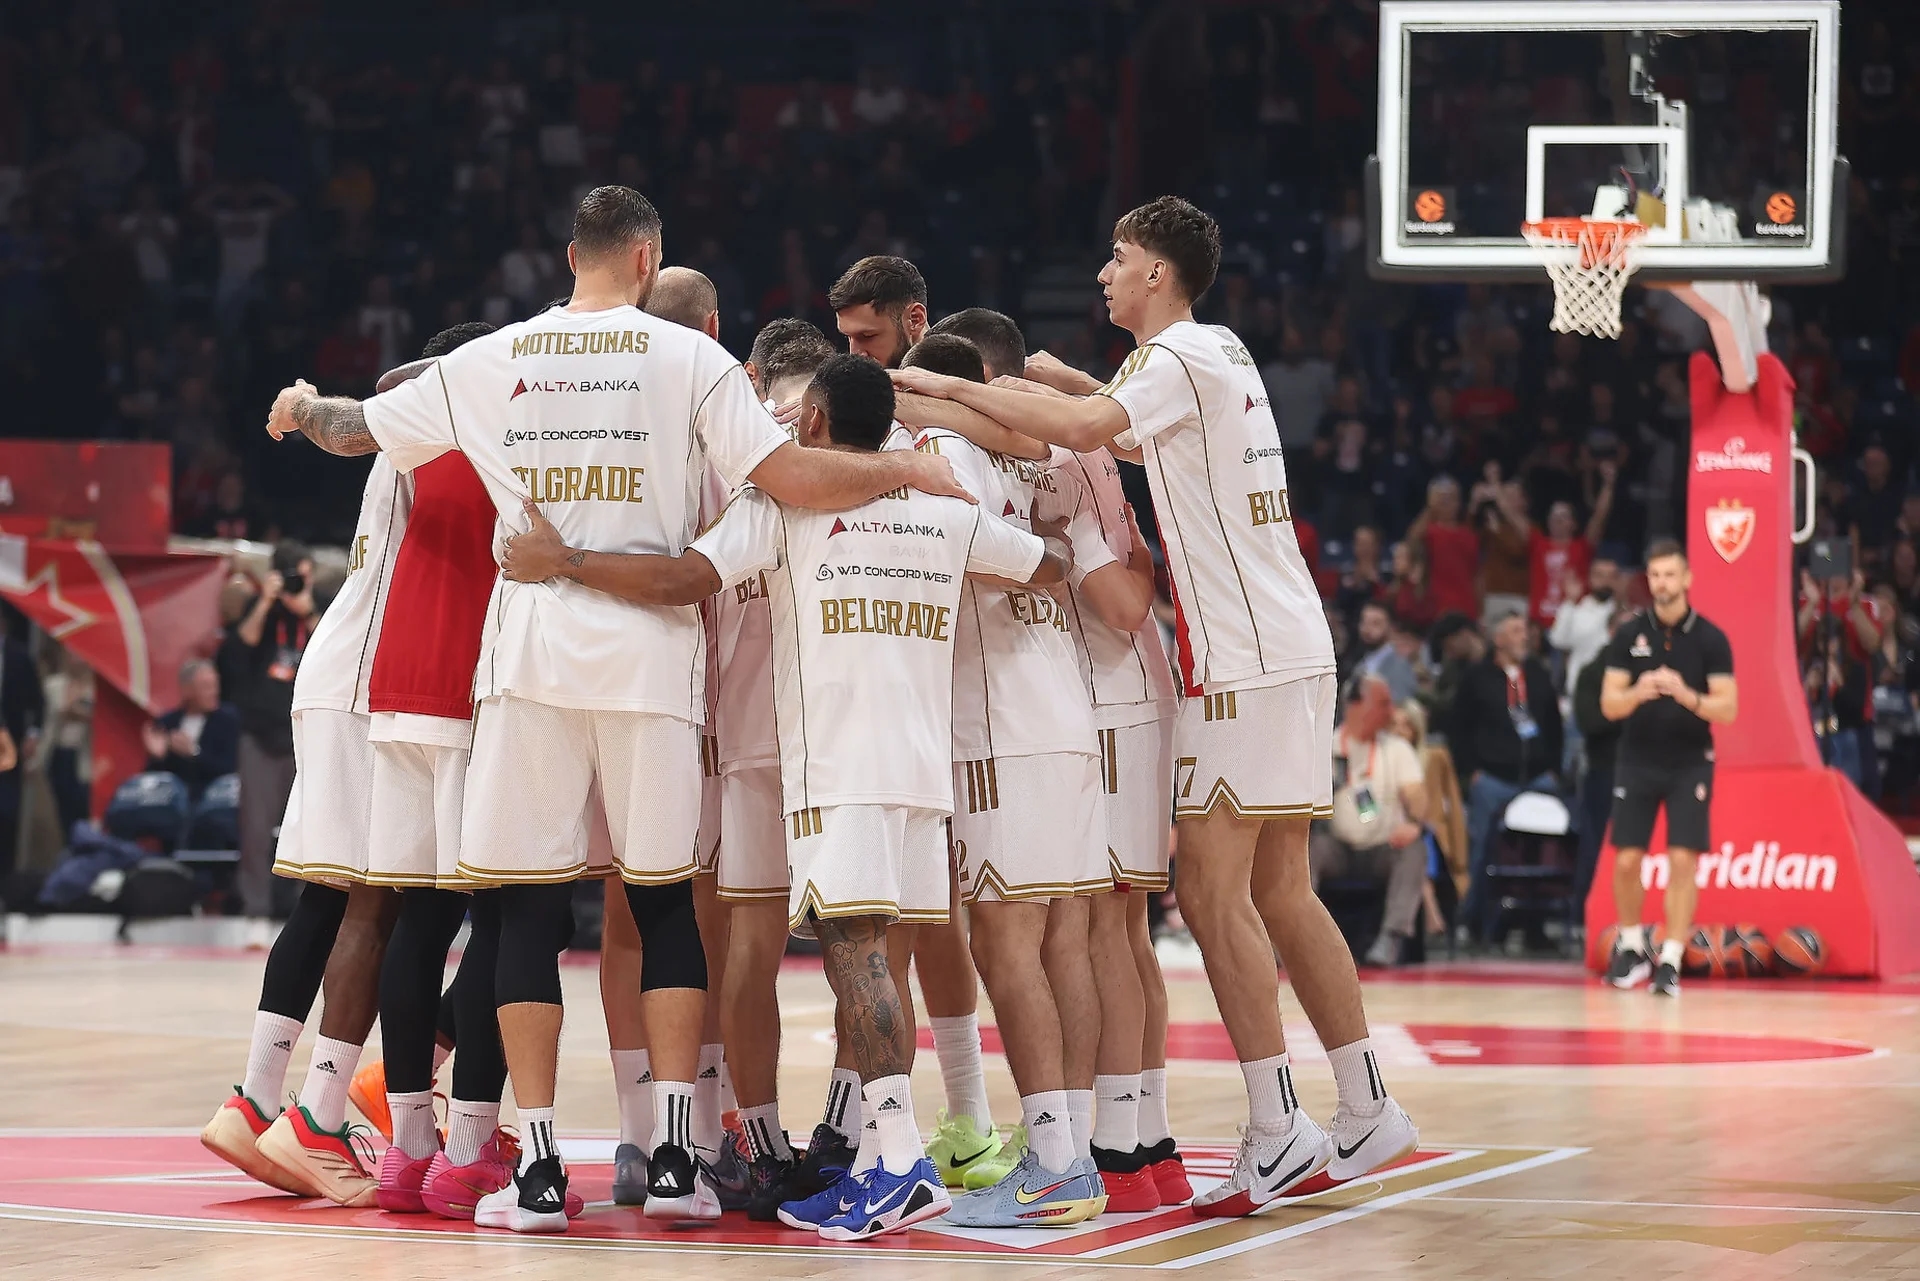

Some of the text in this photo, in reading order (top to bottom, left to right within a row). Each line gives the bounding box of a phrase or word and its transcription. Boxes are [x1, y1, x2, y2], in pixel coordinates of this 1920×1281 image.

[511, 331, 650, 359] MOTIEJUNAS
[541, 429, 608, 441] CONCORD
[610, 429, 650, 441] WEST
[864, 566, 921, 579] CONCORD
[923, 570, 953, 585] WEST
[820, 598, 951, 642] BELGRADE
[1641, 840, 1838, 892] mridian
